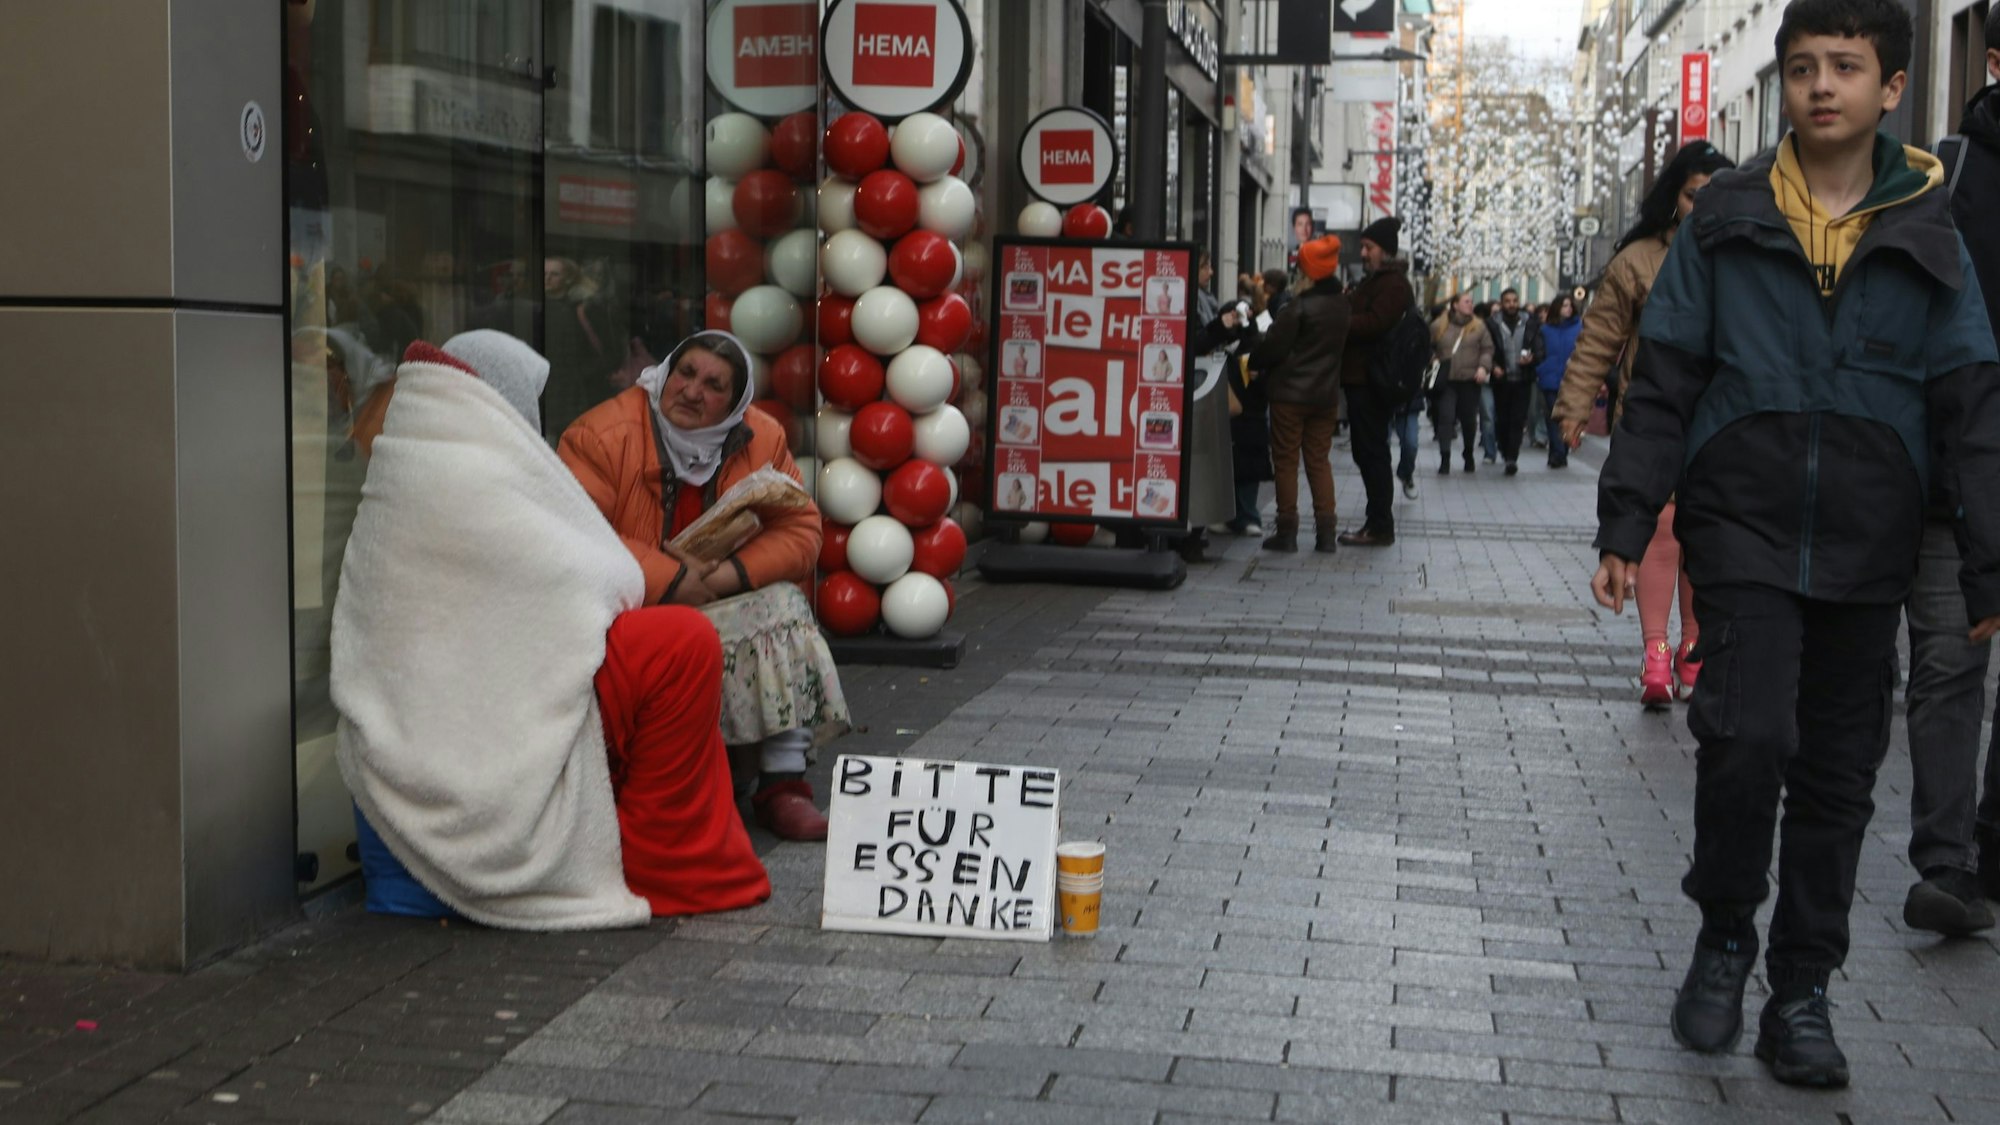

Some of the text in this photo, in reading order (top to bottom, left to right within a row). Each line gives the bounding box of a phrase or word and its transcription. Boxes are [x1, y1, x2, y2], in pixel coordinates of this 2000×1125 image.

[858, 33, 931, 58] HEMA
[1043, 149, 1092, 166] HEMA
[1046, 299, 1092, 339] le
[1044, 360, 1138, 437] al
[888, 806, 994, 848] FÜR
[854, 842, 1031, 892] ESSEN
[878, 886, 1033, 930] DANKE
